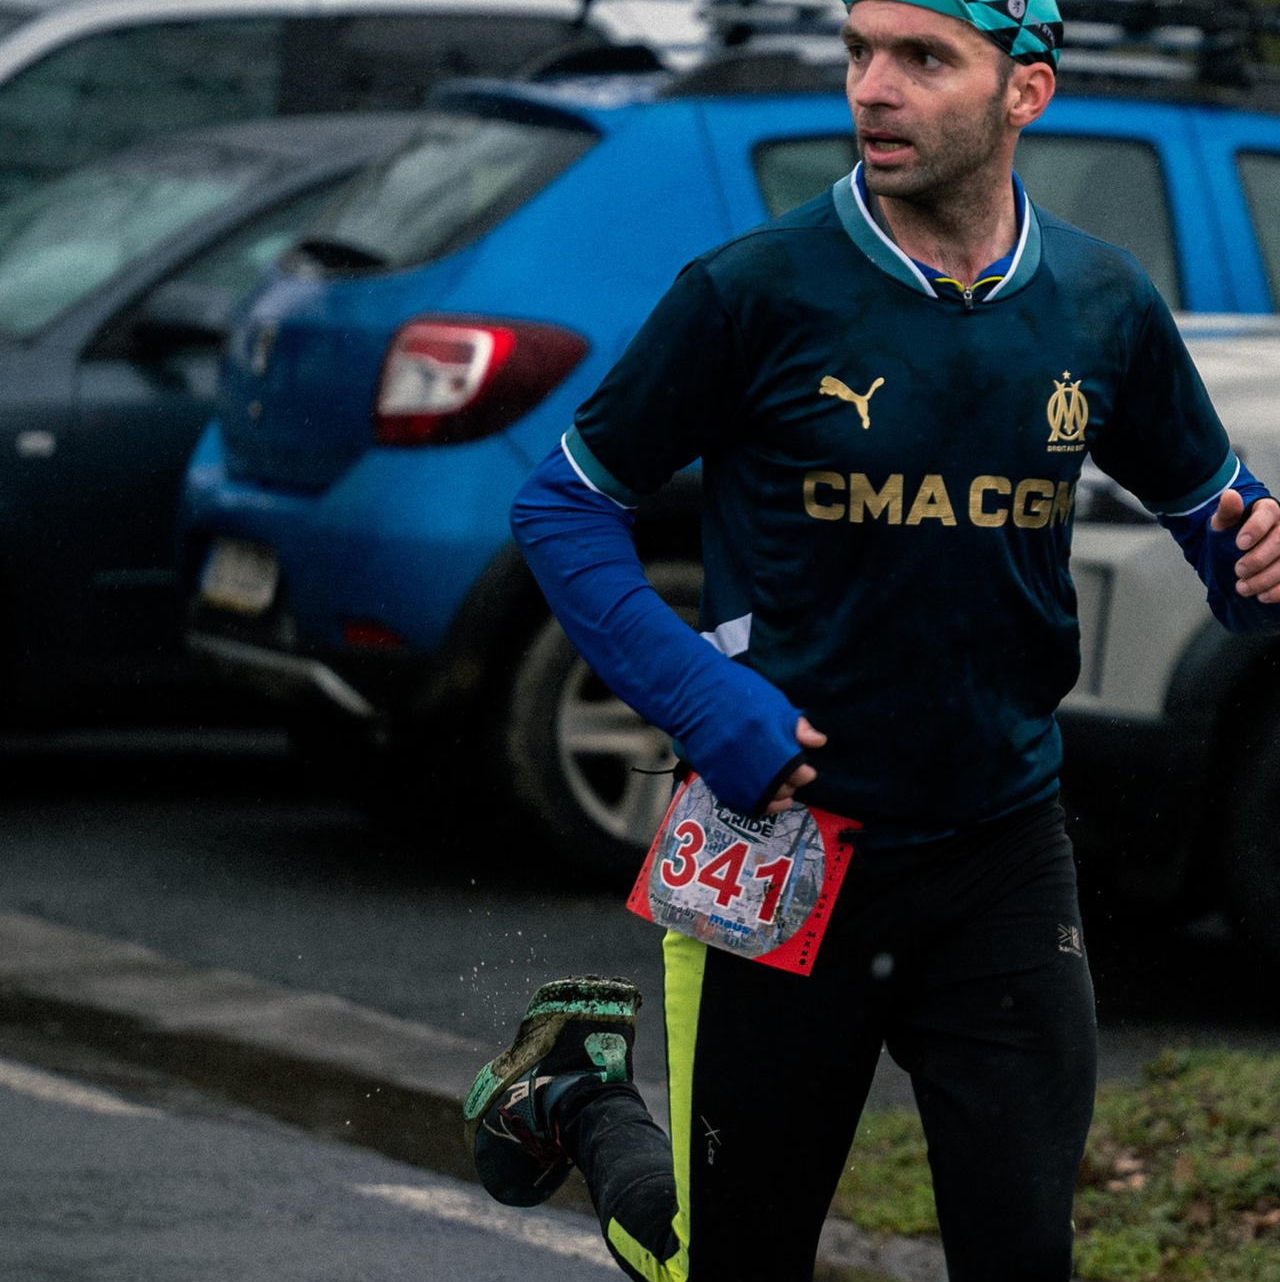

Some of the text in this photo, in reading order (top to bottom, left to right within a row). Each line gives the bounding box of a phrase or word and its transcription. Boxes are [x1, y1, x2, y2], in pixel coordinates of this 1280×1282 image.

[803, 470, 1074, 529] CMA CGM
[661, 819, 793, 925] 341
[649, 893, 697, 919] Powered by
[709, 914, 750, 934] maus
